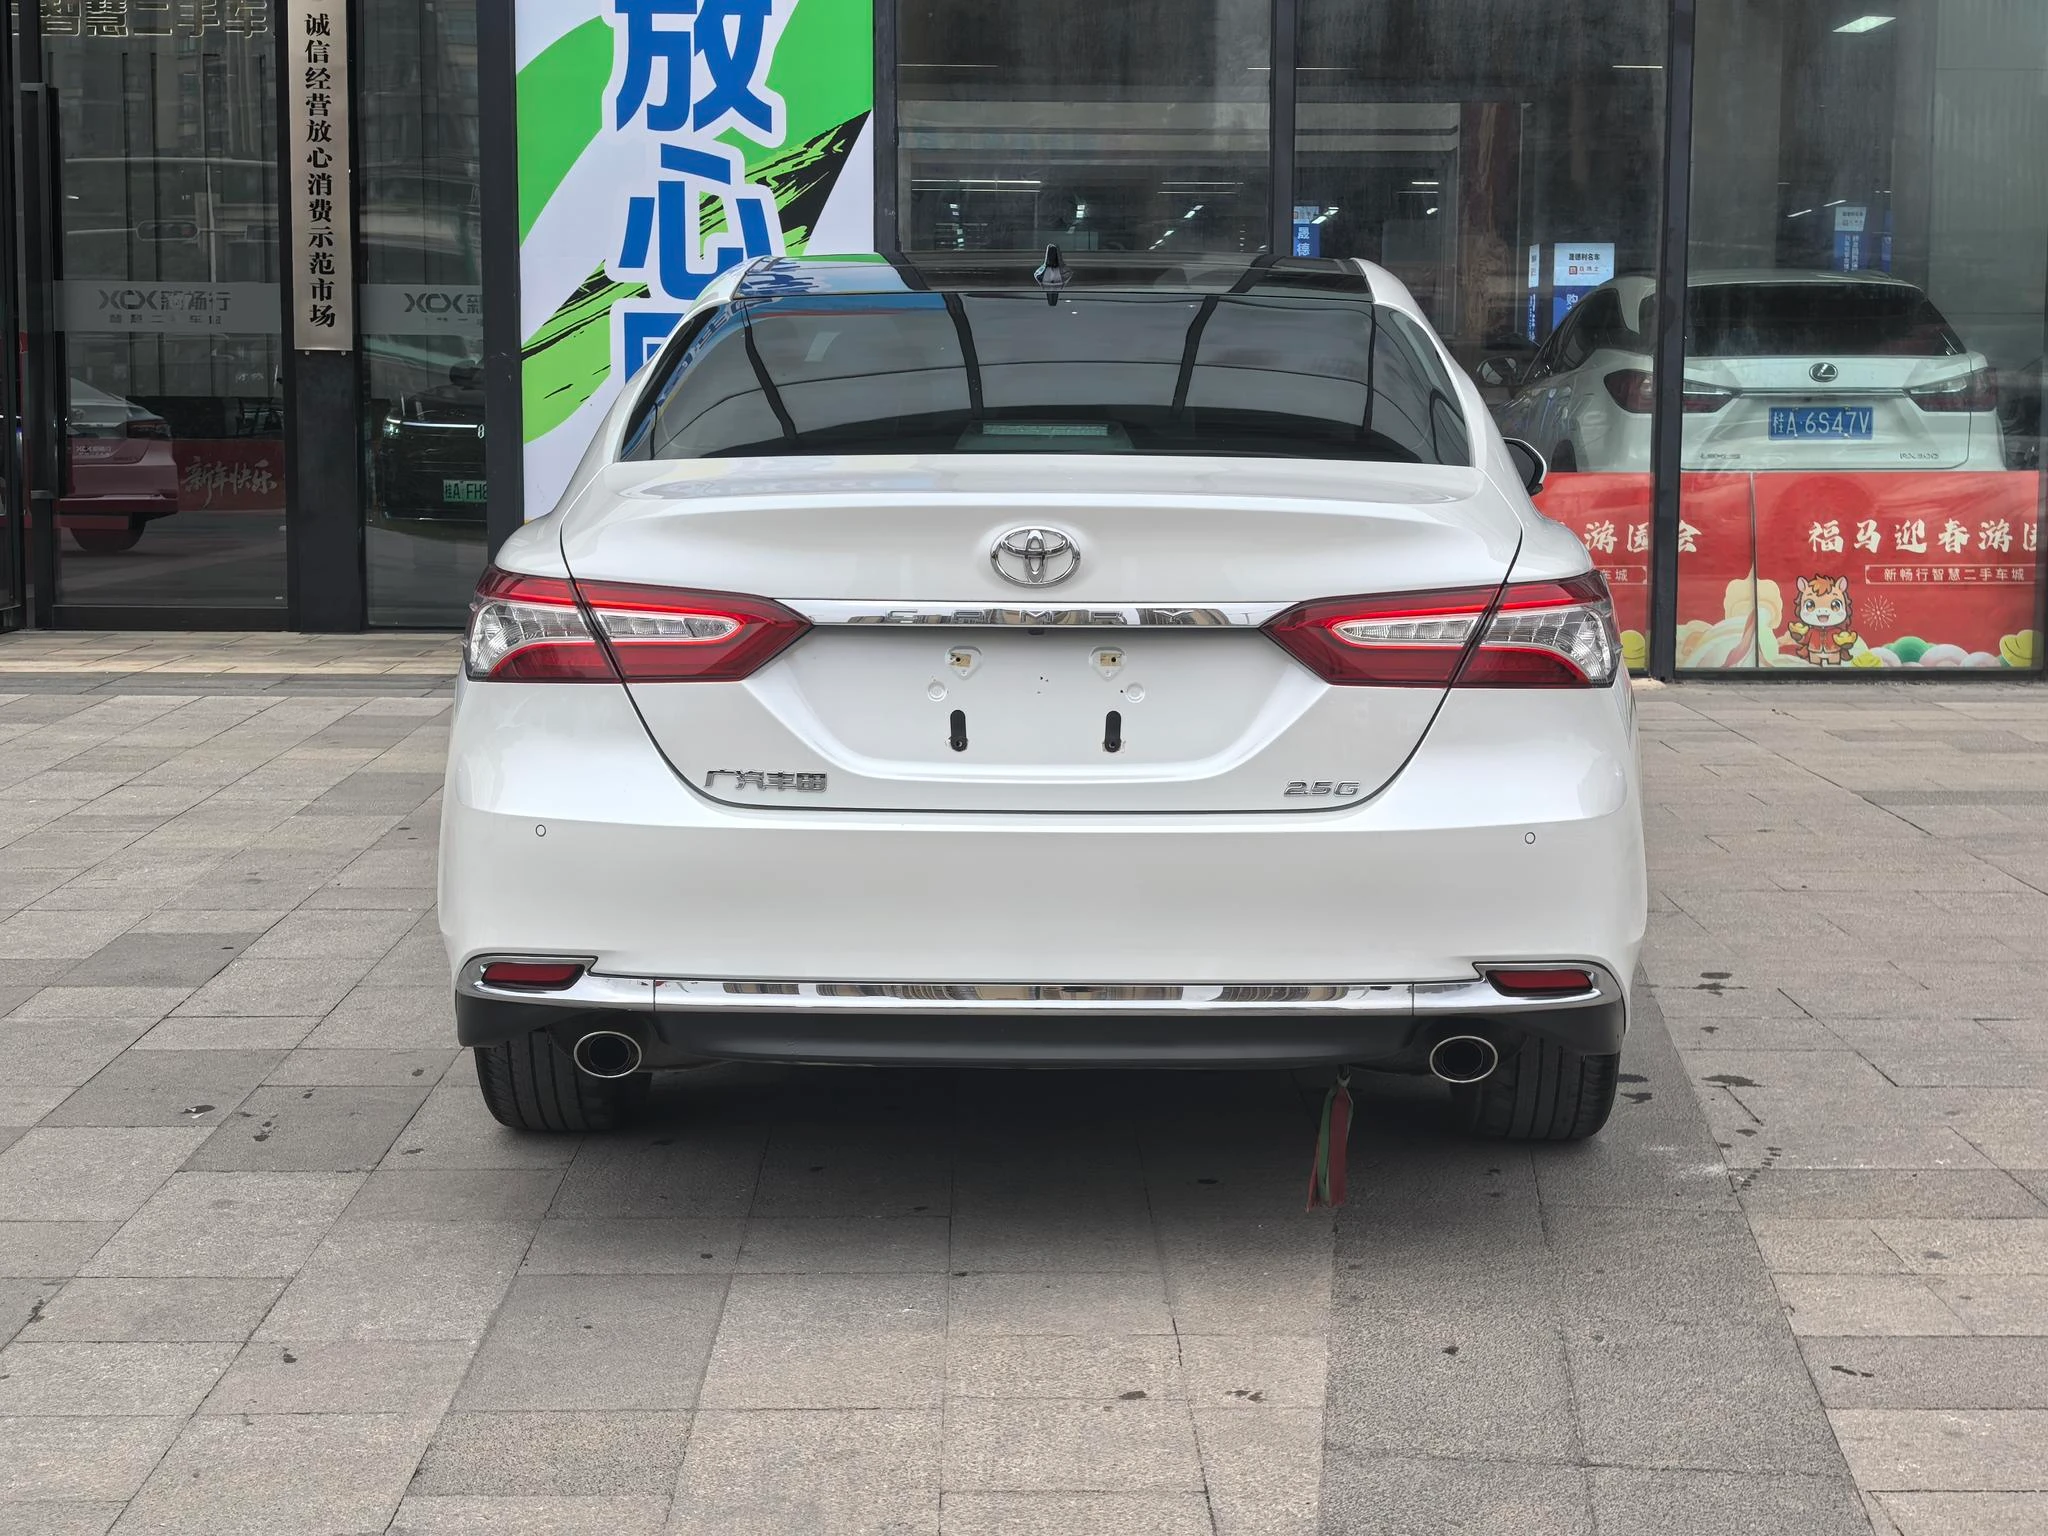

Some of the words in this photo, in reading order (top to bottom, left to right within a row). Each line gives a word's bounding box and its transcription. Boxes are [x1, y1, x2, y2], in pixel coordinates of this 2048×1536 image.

[304, 13, 336, 328] 诚信经营放心消费示范市场
[1884, 568, 2025, 582] 新畅行智慧二手车城
[886, 609, 1195, 625] CAMRY
[704, 769, 828, 792] 广汽丰田
